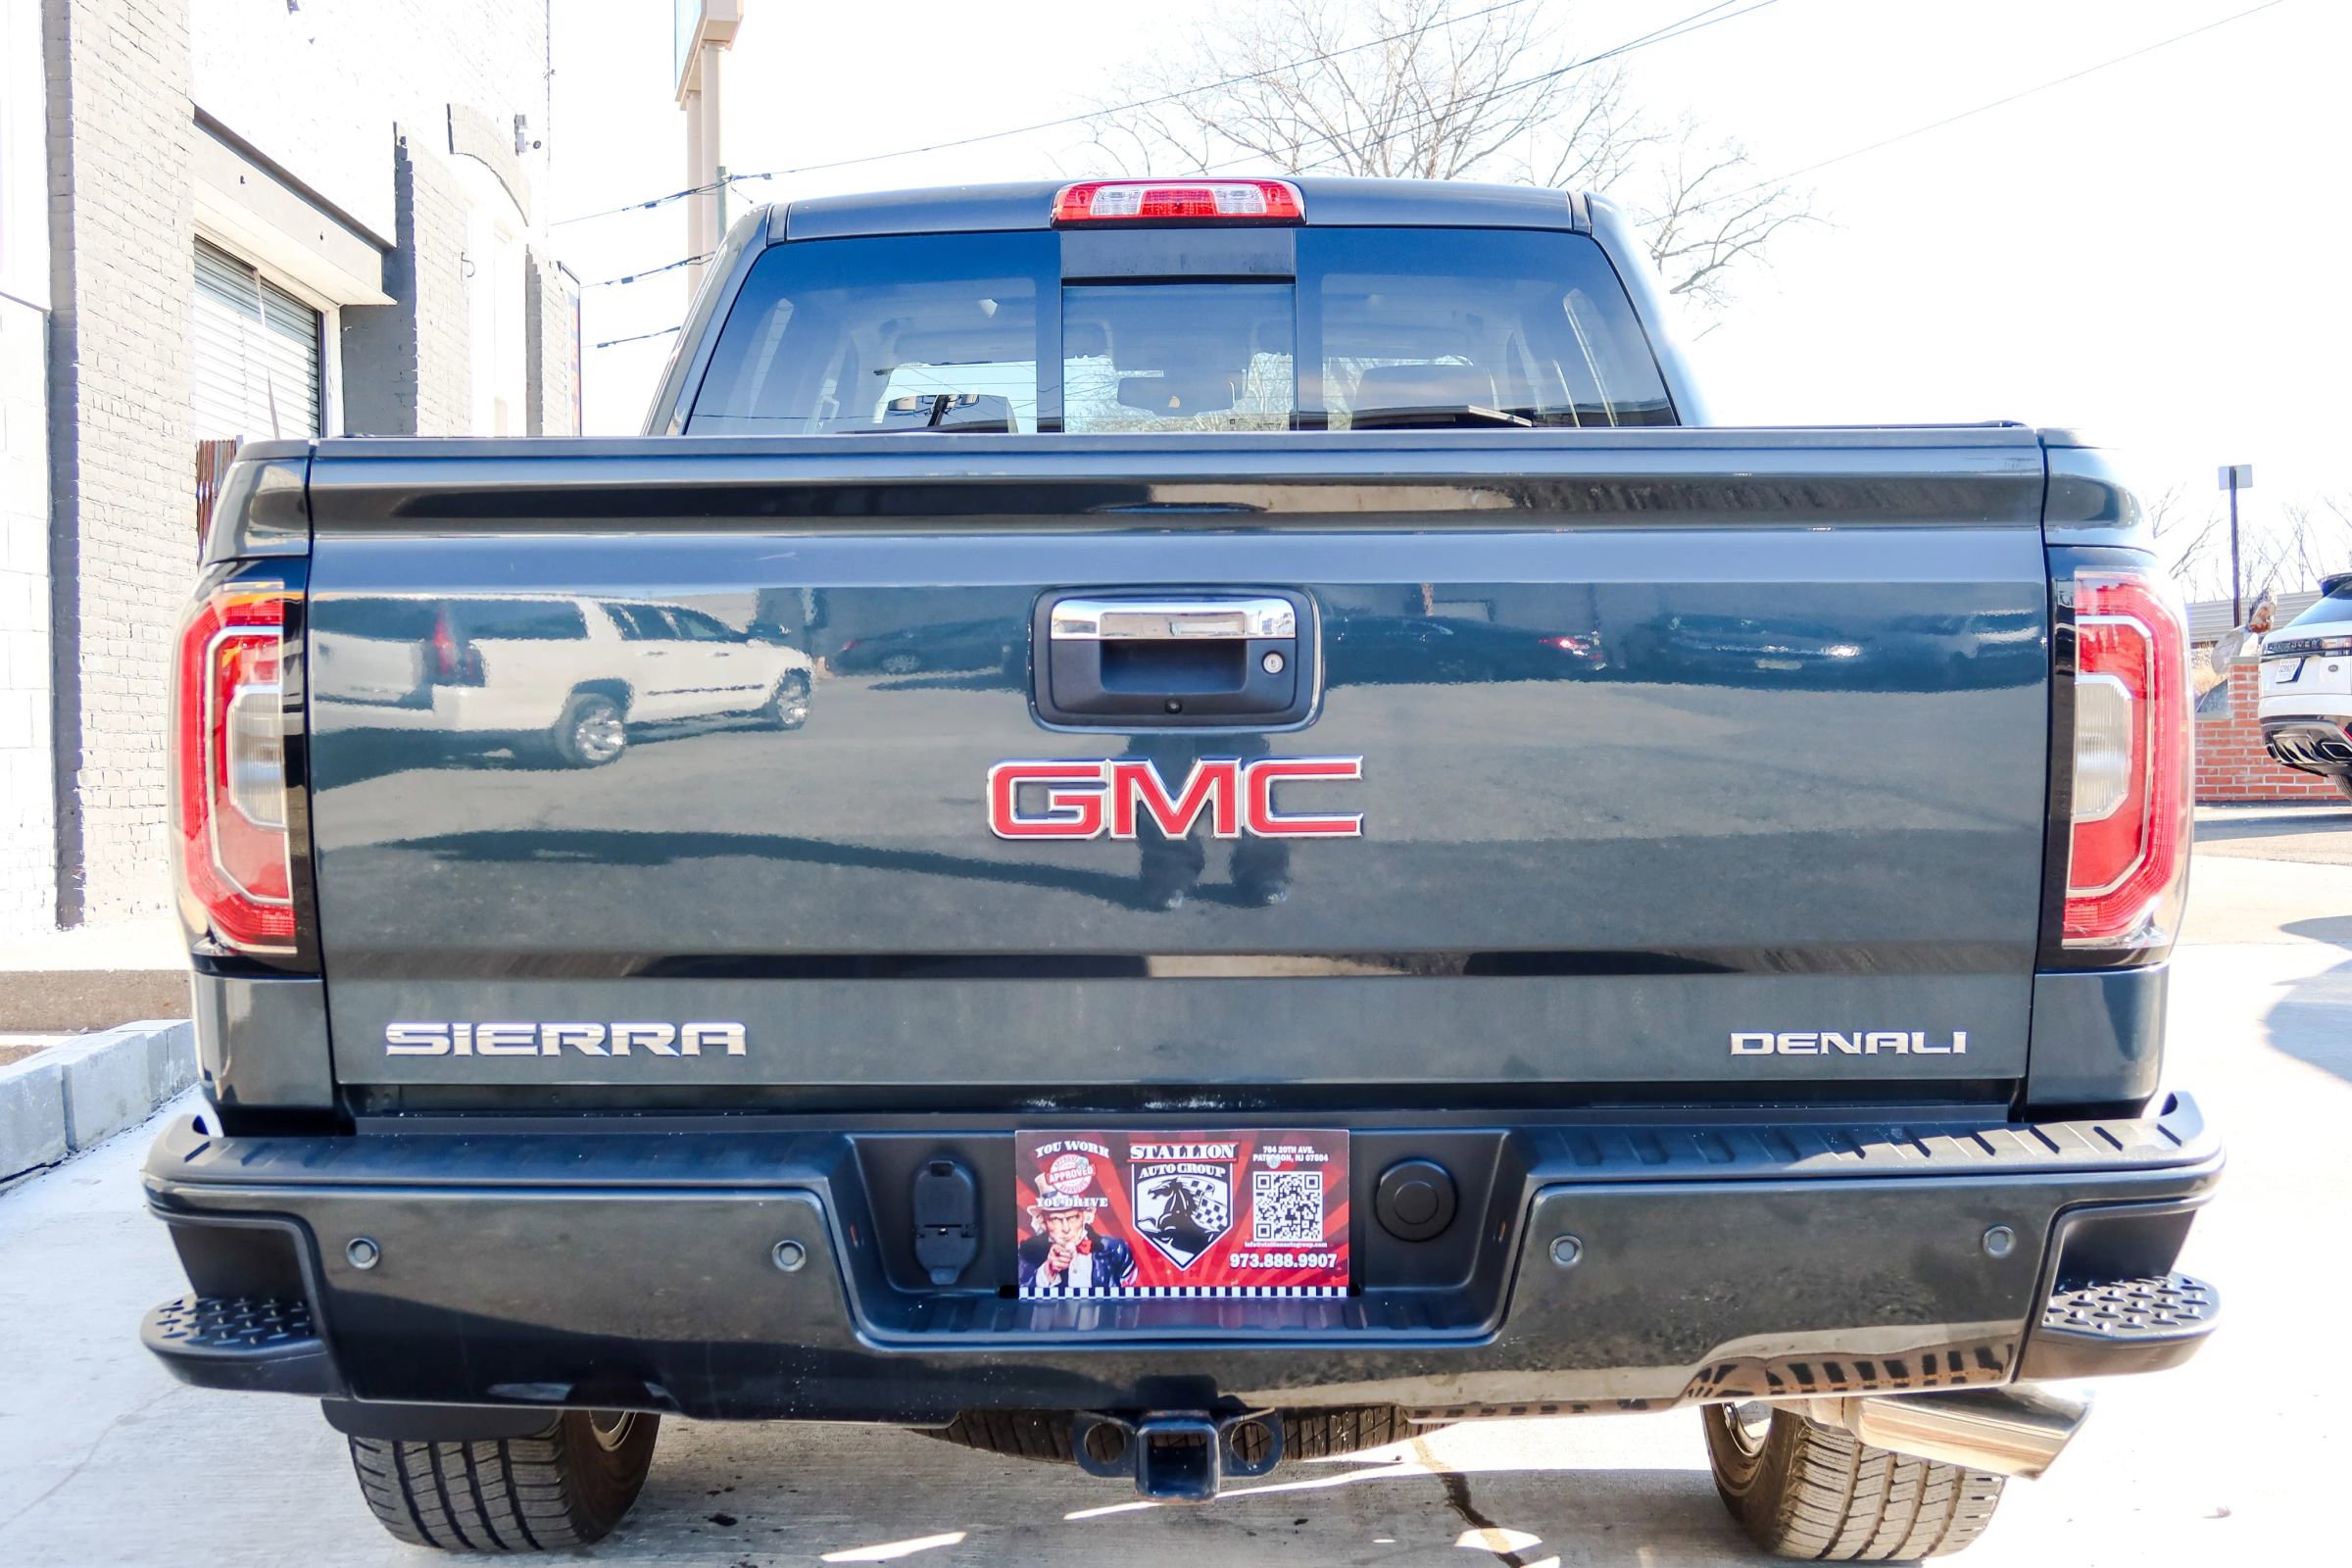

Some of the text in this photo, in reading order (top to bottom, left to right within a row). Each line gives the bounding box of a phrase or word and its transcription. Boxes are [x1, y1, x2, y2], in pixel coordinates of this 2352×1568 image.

[987, 756, 1363, 840] GMC
[386, 1022, 747, 1056] SIERRA
[1731, 1031, 1967, 1055] DENALI
[1035, 1141, 1110, 1159] YOU WORK
[1130, 1145, 1237, 1160] STALLION
[1252, 1154, 1294, 1163] PATEON,
[1278, 1146, 1297, 1154] 20TH
[1298, 1146, 1315, 1154] AVE.
[1049, 1165, 1095, 1184] APPROVED
[1138, 1163, 1227, 1180] AUTO GROUP
[1035, 1197, 1108, 1207] YOU DRIVE
[1229, 1252, 1338, 1268] 973.888.9907
